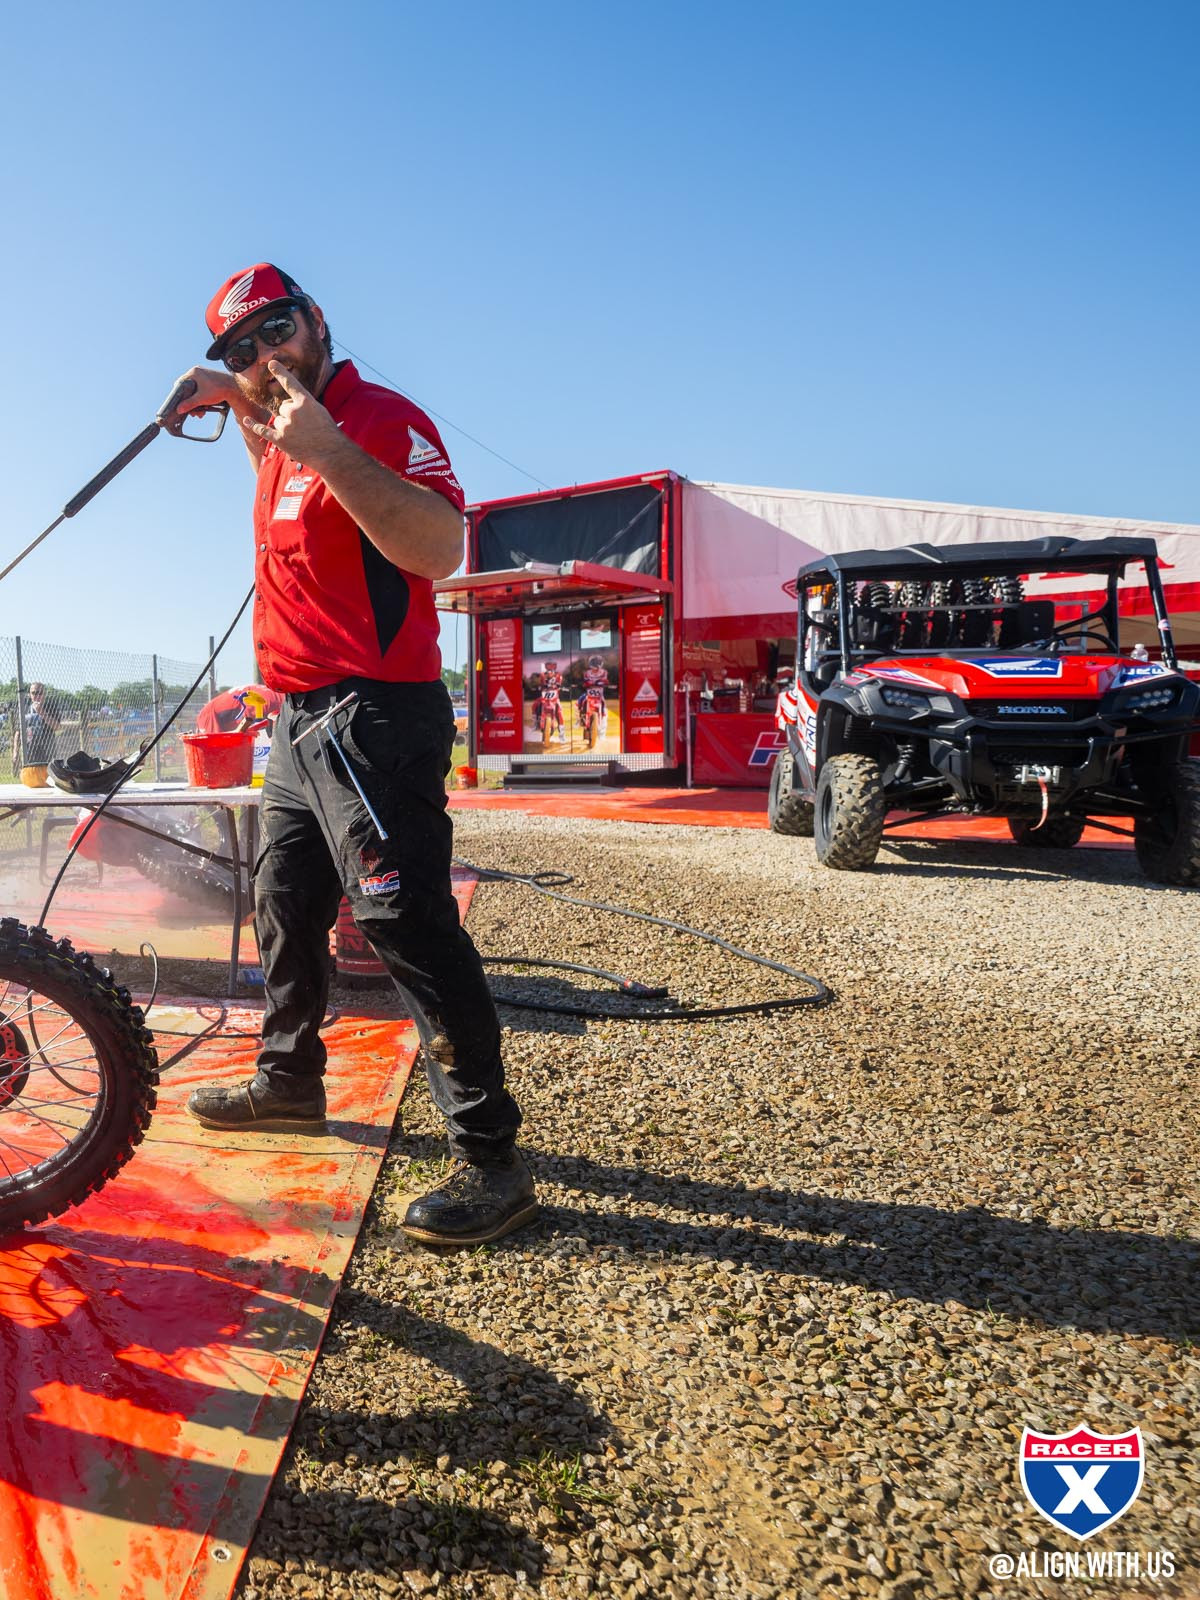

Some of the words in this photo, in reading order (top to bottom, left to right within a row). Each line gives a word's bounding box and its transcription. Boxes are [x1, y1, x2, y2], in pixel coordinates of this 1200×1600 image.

[222, 296, 270, 330] HONDA
[998, 705, 1067, 715] HONDA
[360, 870, 400, 892] HRC
